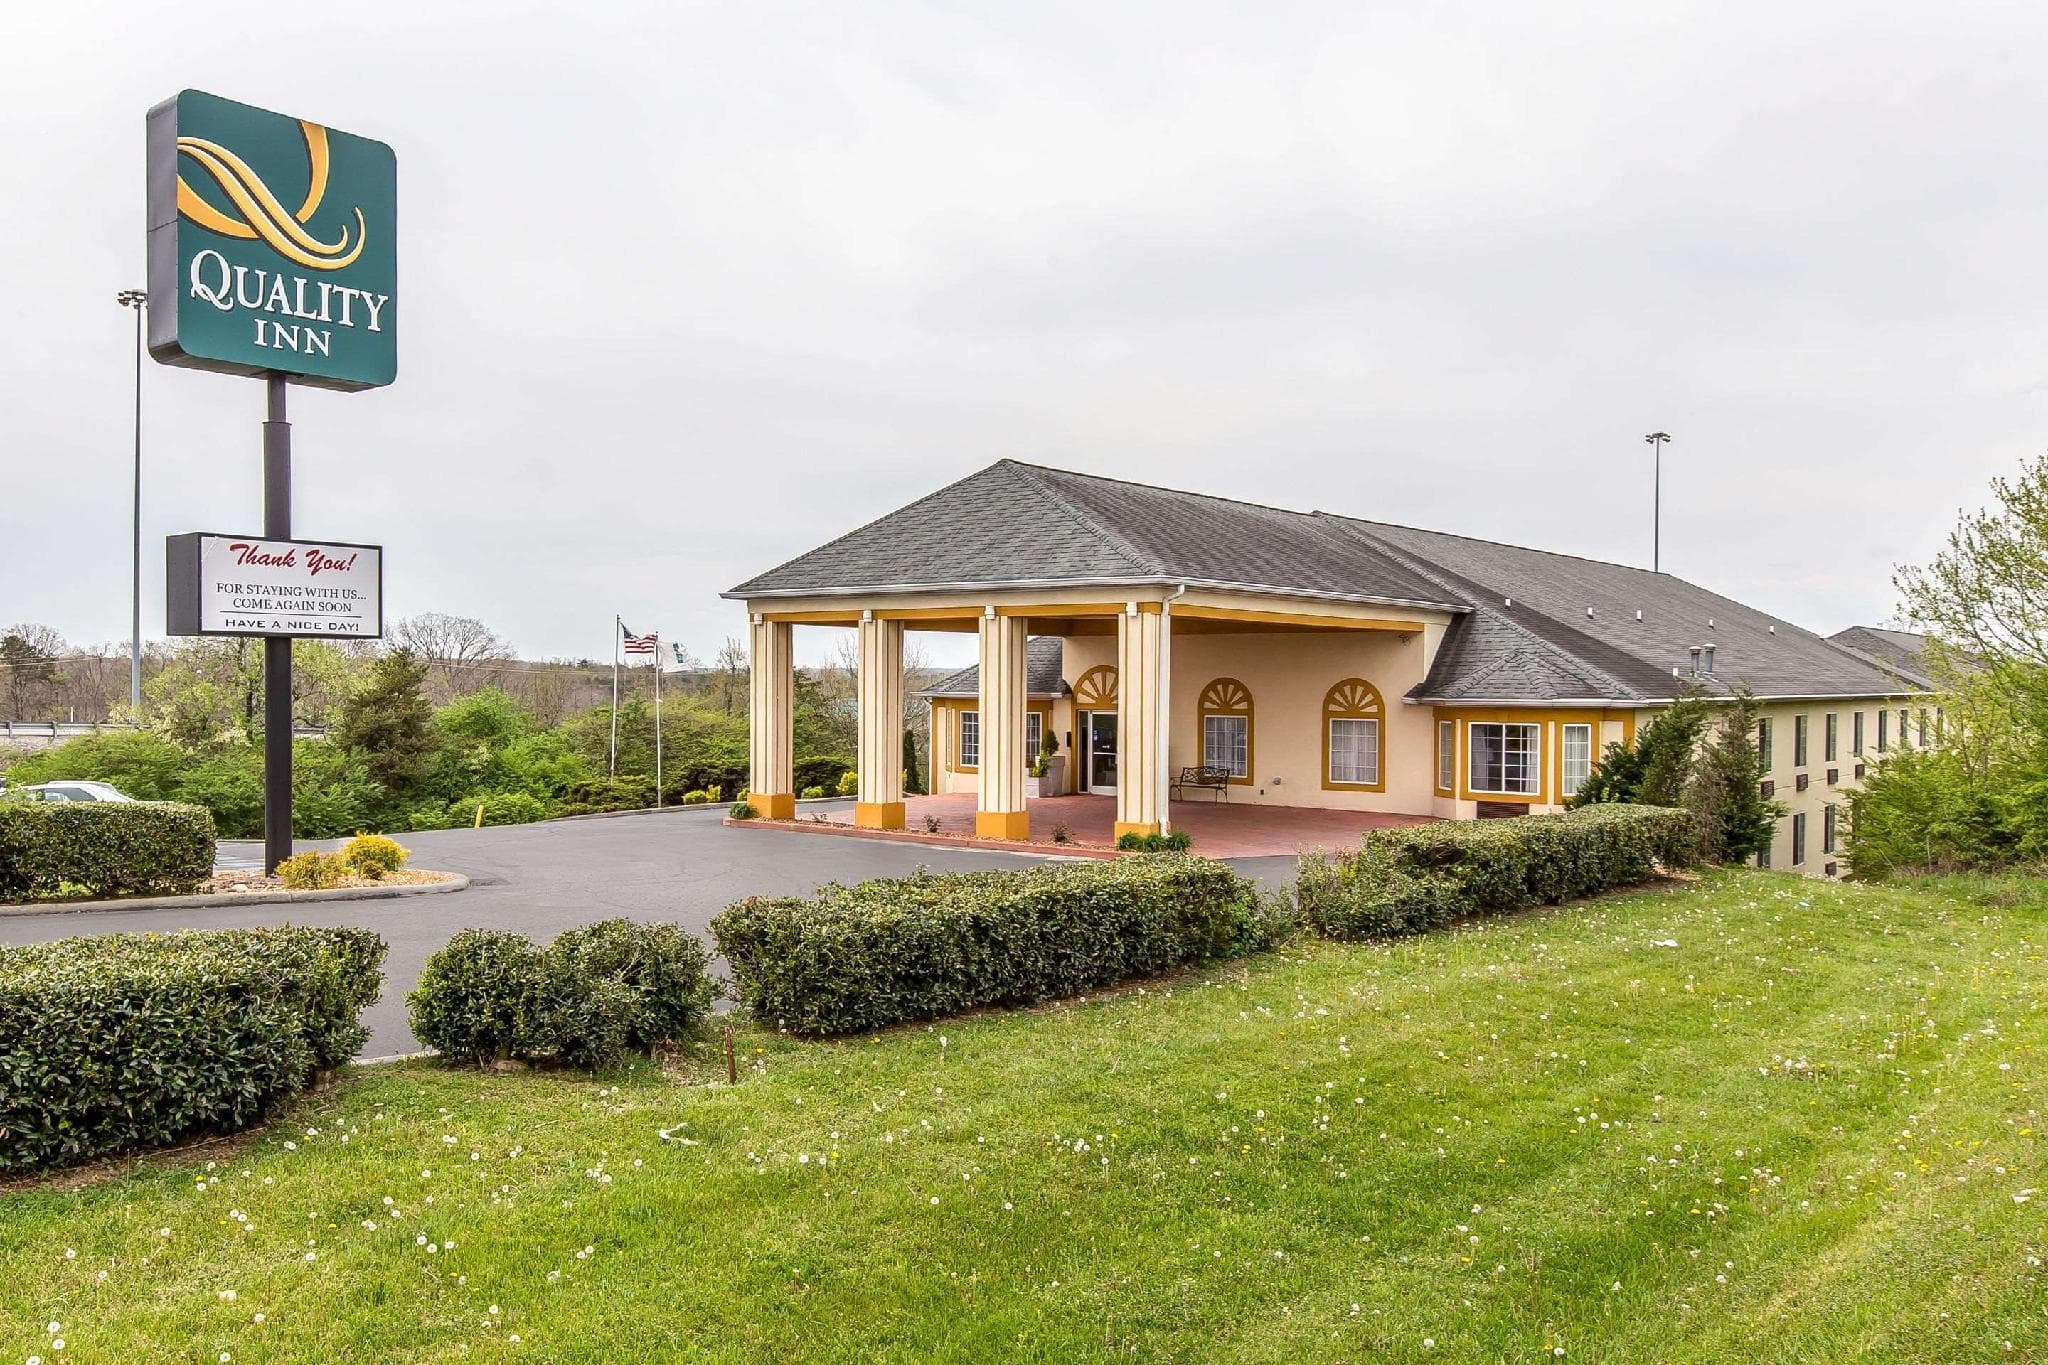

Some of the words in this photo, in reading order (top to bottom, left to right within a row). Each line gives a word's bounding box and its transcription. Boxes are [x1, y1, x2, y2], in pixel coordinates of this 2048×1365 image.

[191, 249, 389, 333] QUALITY
[254, 318, 332, 358] INN
[229, 543, 297, 568] Thank
[305, 549, 358, 576] You!
[216, 582, 243, 594] FOR
[246, 584, 302, 597] STAYING
[304, 587, 339, 599] WITH
[342, 589, 367, 600] US...
[233, 598, 272, 610] COME
[275, 600, 315, 612] AGAIN
[318, 602, 352, 613] SOON
[225, 618, 266, 628] HAVE
[271, 620, 281, 629] A
[287, 621, 322, 630] NICE
[328, 622, 360, 632] DAY!
